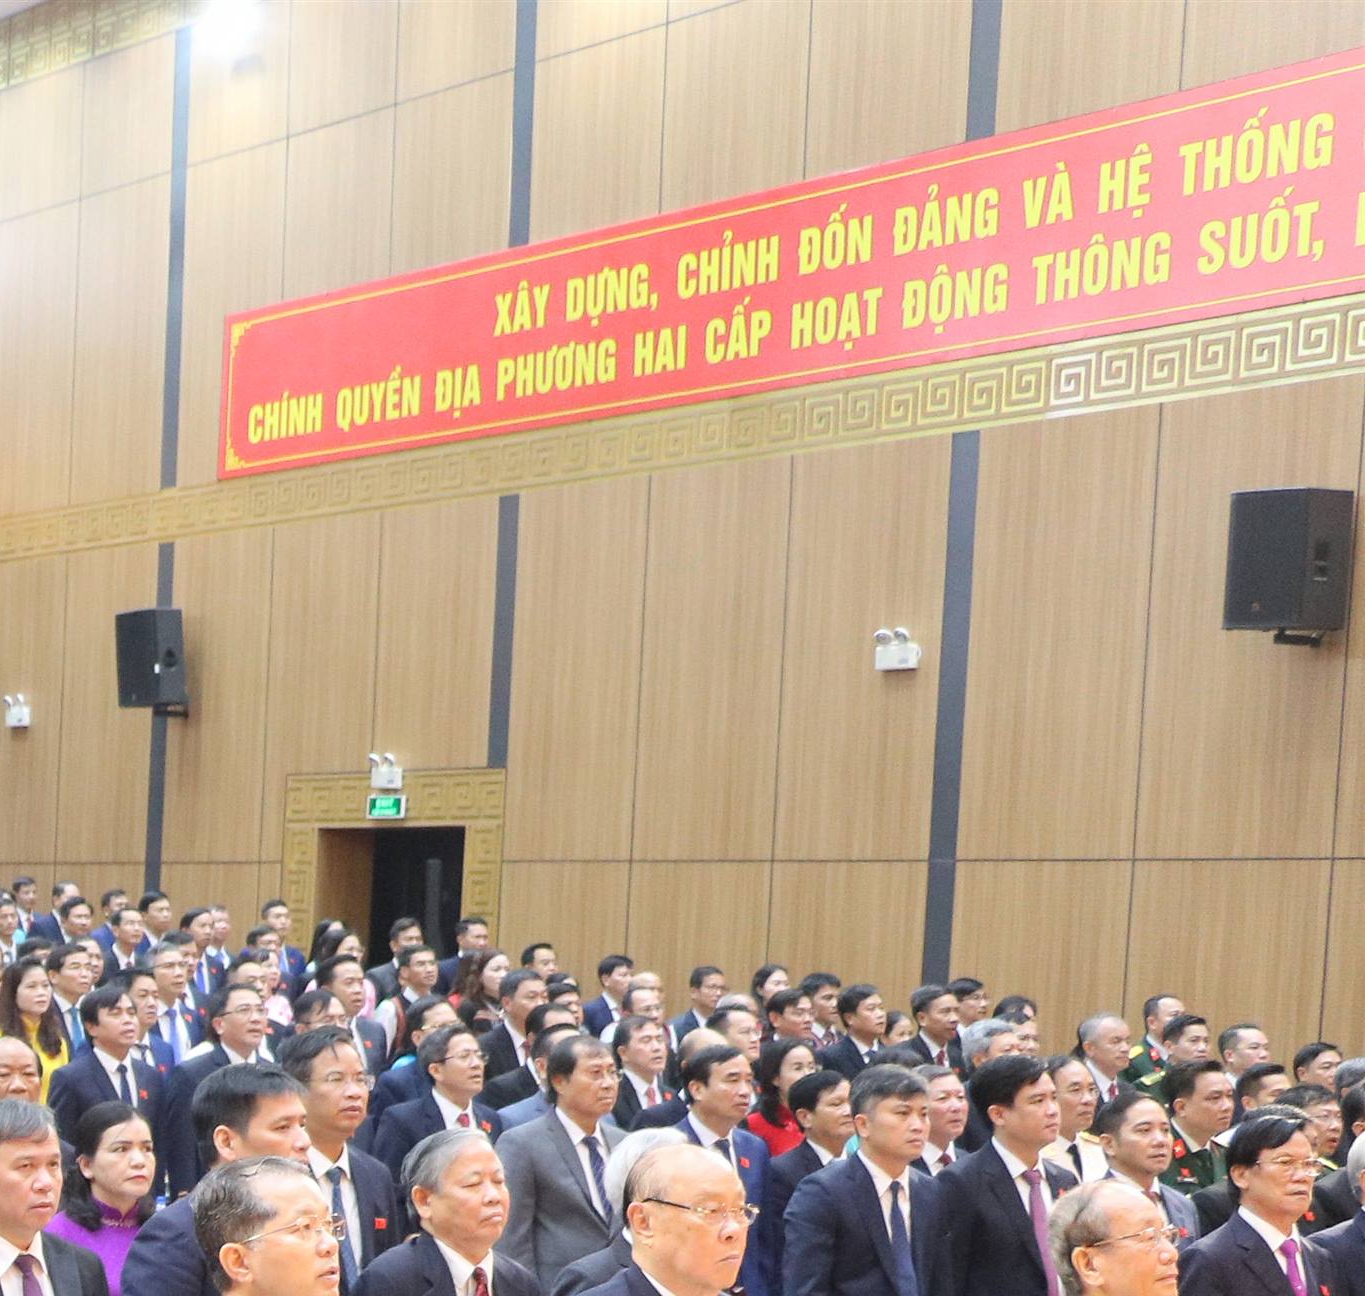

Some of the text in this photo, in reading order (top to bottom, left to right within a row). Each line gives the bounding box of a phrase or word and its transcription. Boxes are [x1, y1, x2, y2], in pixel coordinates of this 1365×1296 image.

[247, 390, 322, 445] CHÍNH
[435, 366, 481, 418] ĐỊA
[496, 337, 616, 401] PHƯƠNG
[633, 324, 687, 376] HAI
[704, 296, 772, 364] CẤP
[790, 287, 883, 351] HOẠT
[901, 262, 1009, 335] ĐỘNG
[1031, 230, 1171, 306] THÔNG
[1196, 185, 1326, 276] SUỐT,
[493, 106, 1335, 337] XÂY DỰNG, CHỈNH ĐỐN ĐẢNG VÀ HỆ THỐNG
